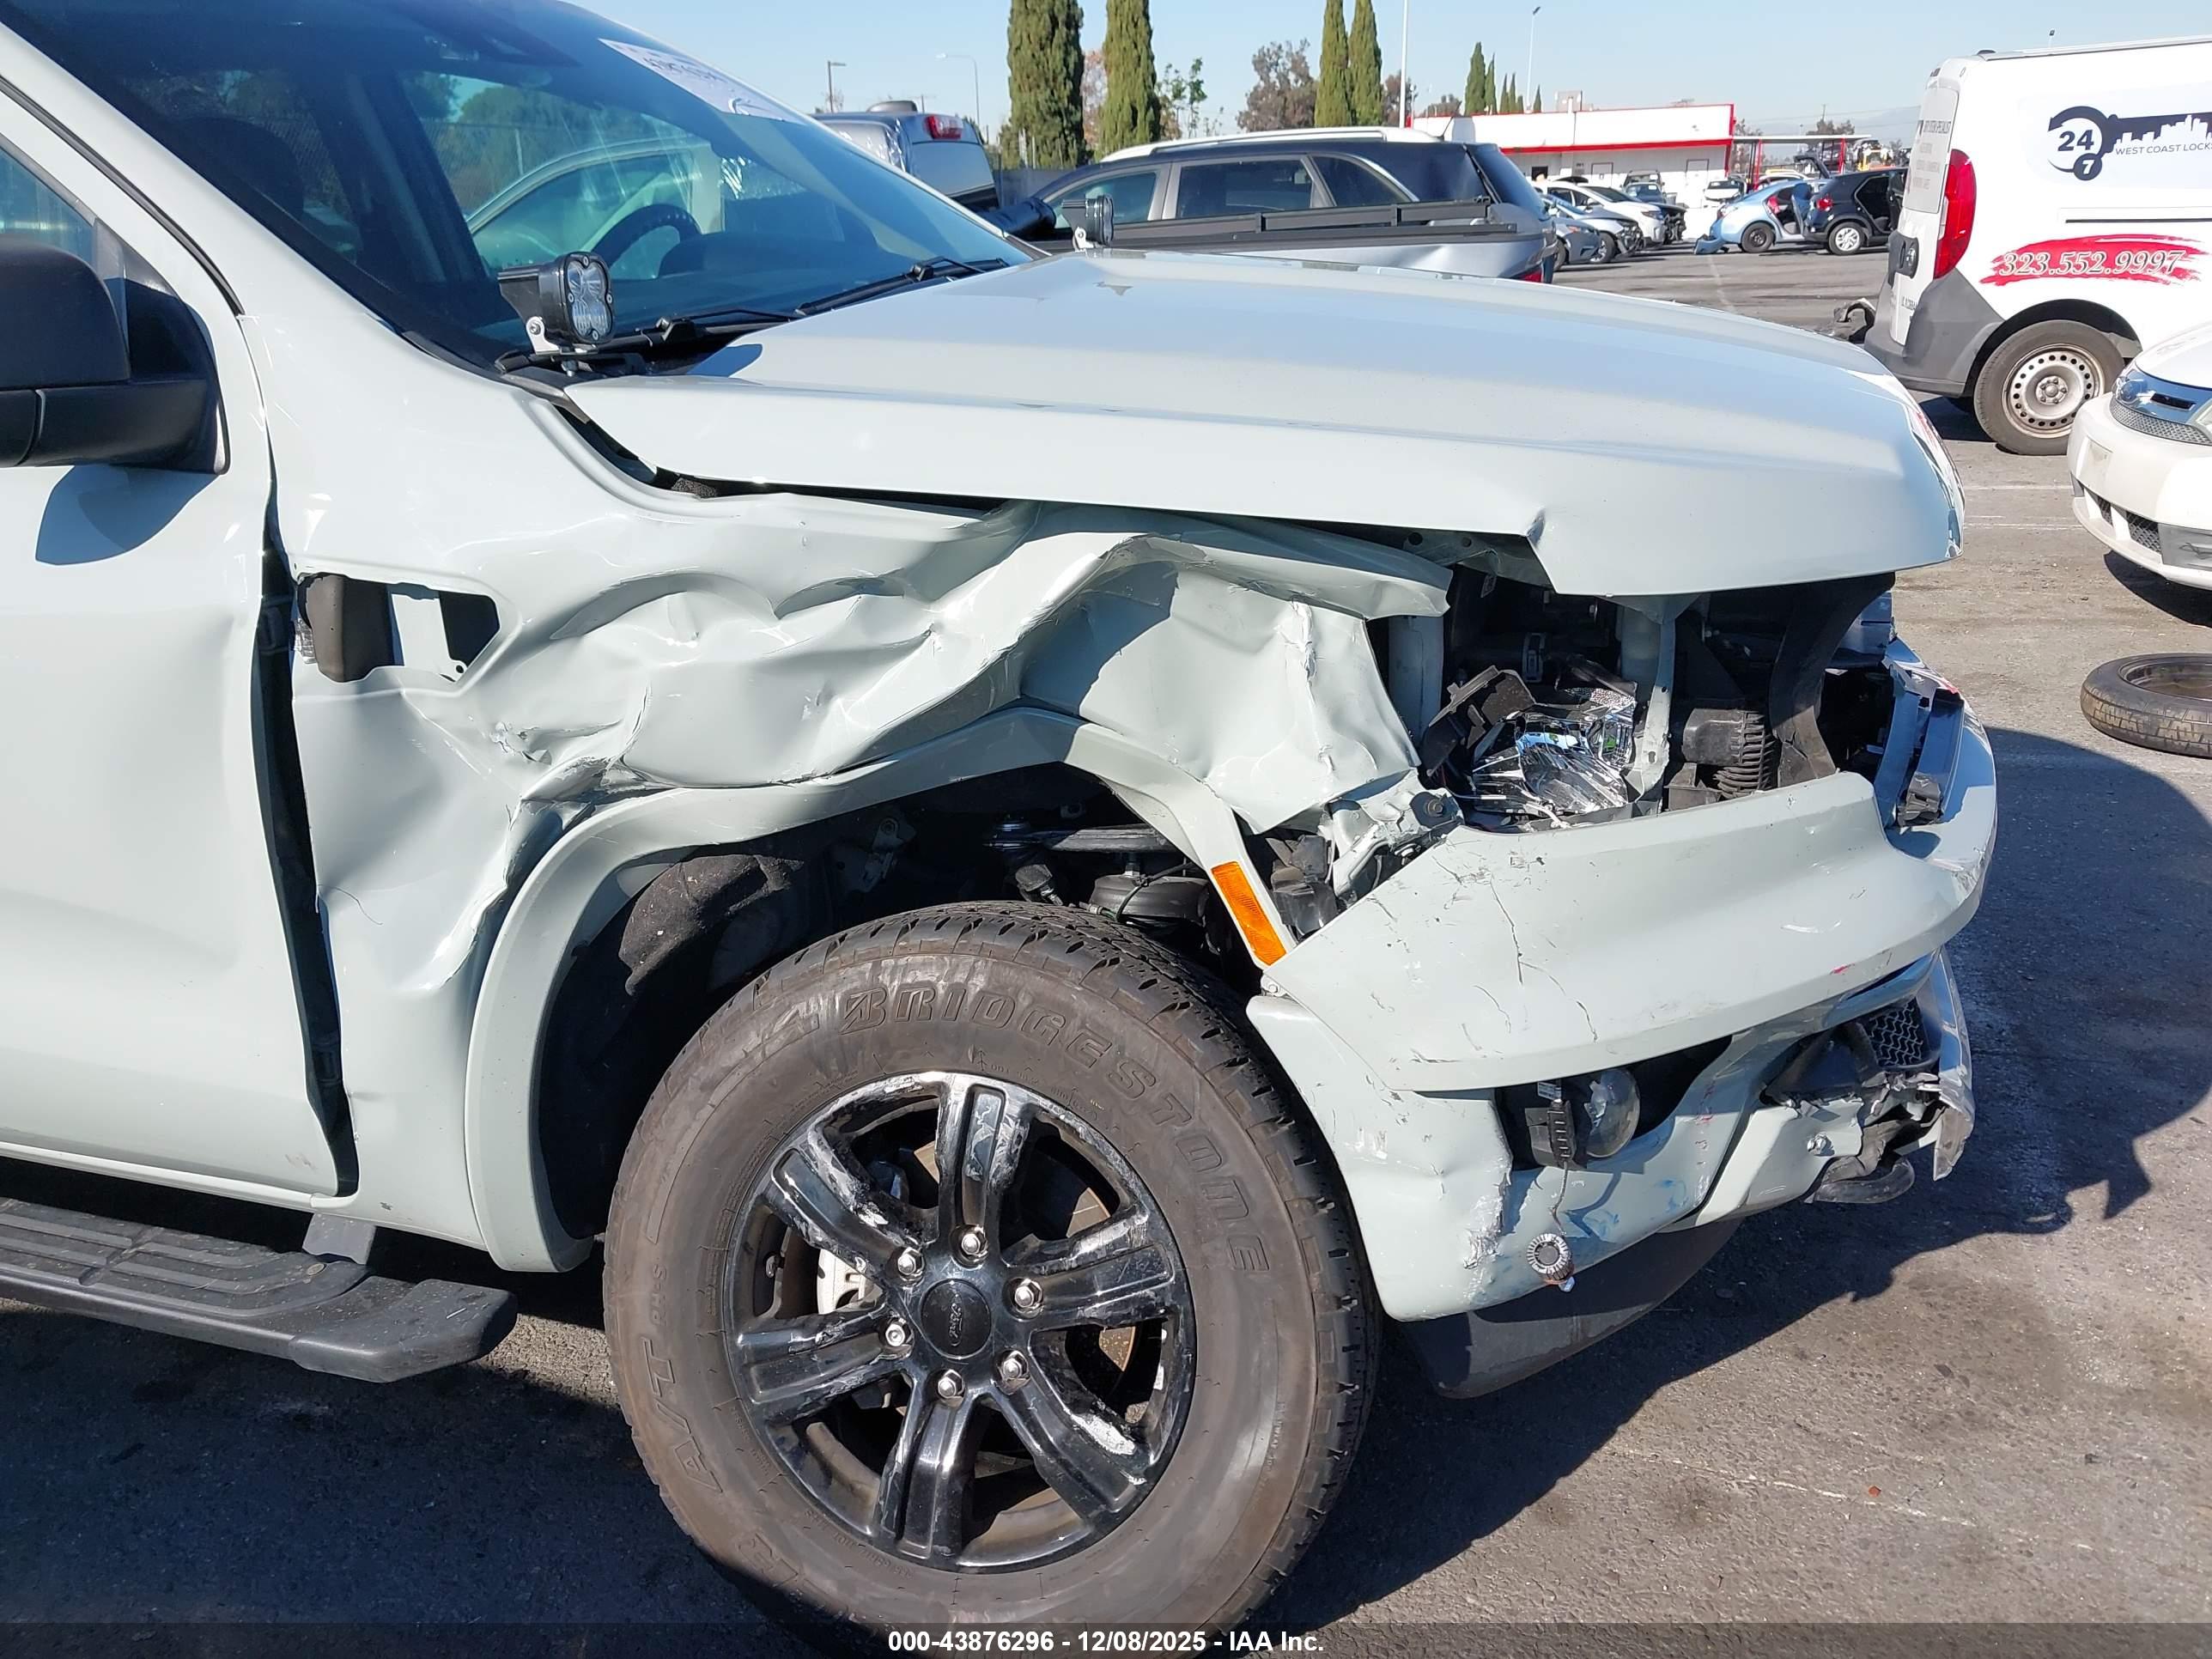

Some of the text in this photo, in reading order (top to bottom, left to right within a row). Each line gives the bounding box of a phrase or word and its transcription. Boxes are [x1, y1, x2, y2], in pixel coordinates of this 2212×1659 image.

[2057, 129, 2094, 152] 24
[2115, 142, 2212, 155] WEST COAST LOCK
[2081, 159, 2096, 176] 7
[1999, 250, 2187, 276] 323.552.9997
[841, 986, 1270, 1272] BRIDGESTONE
